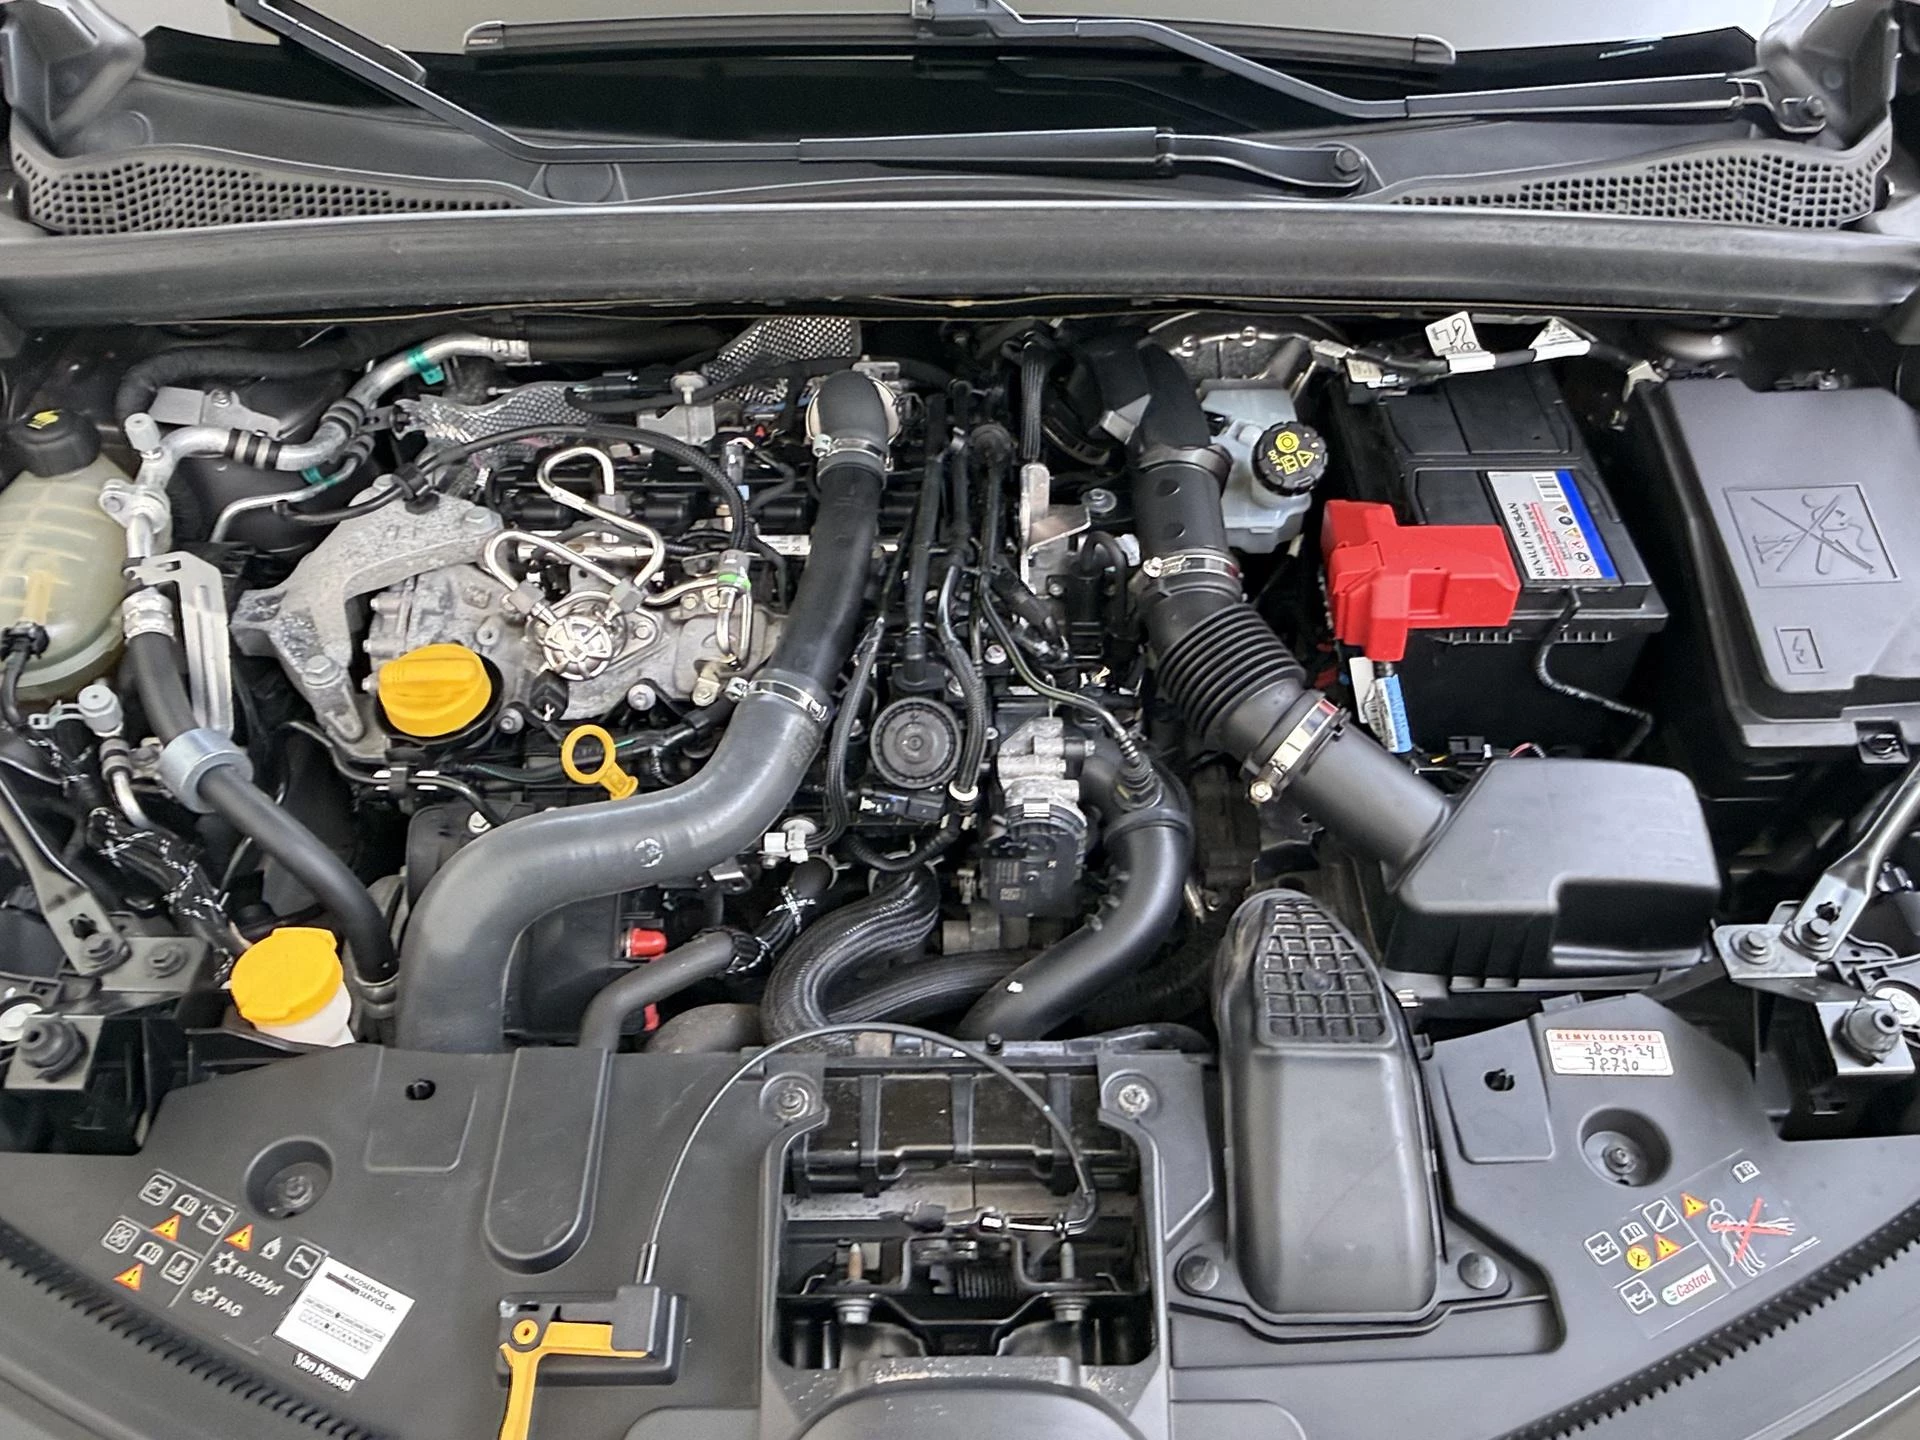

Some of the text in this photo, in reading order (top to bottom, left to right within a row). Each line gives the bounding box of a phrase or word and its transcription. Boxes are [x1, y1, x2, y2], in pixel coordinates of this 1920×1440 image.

[1508, 503, 1530, 538] NISSAN
[1675, 1270, 1713, 1298] Castrol
[212, 1296, 244, 1317] PAG
[293, 1352, 357, 1392] Van Mossel
